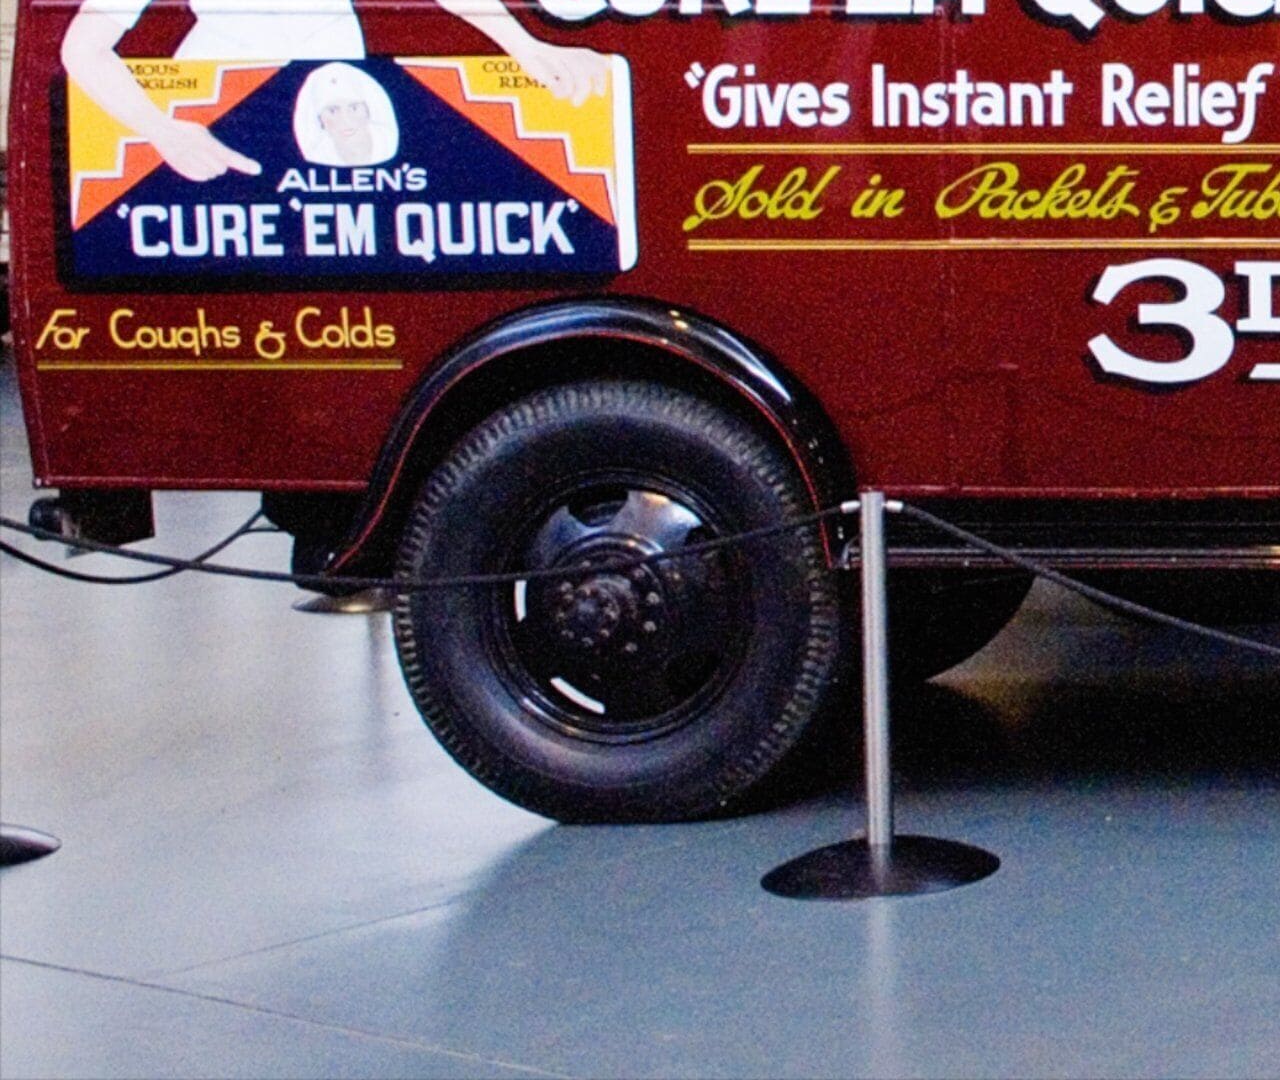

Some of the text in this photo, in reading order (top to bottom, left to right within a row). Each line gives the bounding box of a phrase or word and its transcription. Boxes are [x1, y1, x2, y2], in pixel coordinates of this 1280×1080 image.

[684, 62, 851, 129] "Gives
[872, 63, 1073, 127] Instant
[277, 163, 428, 193] ALLEN'S
[683, 165, 840, 231] Sold
[852, 175, 908, 219] in
[935, 162, 1139, 221] Packets
[1149, 186, 1186, 233] &
[117, 203, 284, 258] "CURE
[397, 199, 580, 264] QUICK"
[36, 306, 396, 360] For Coughs & Colds
